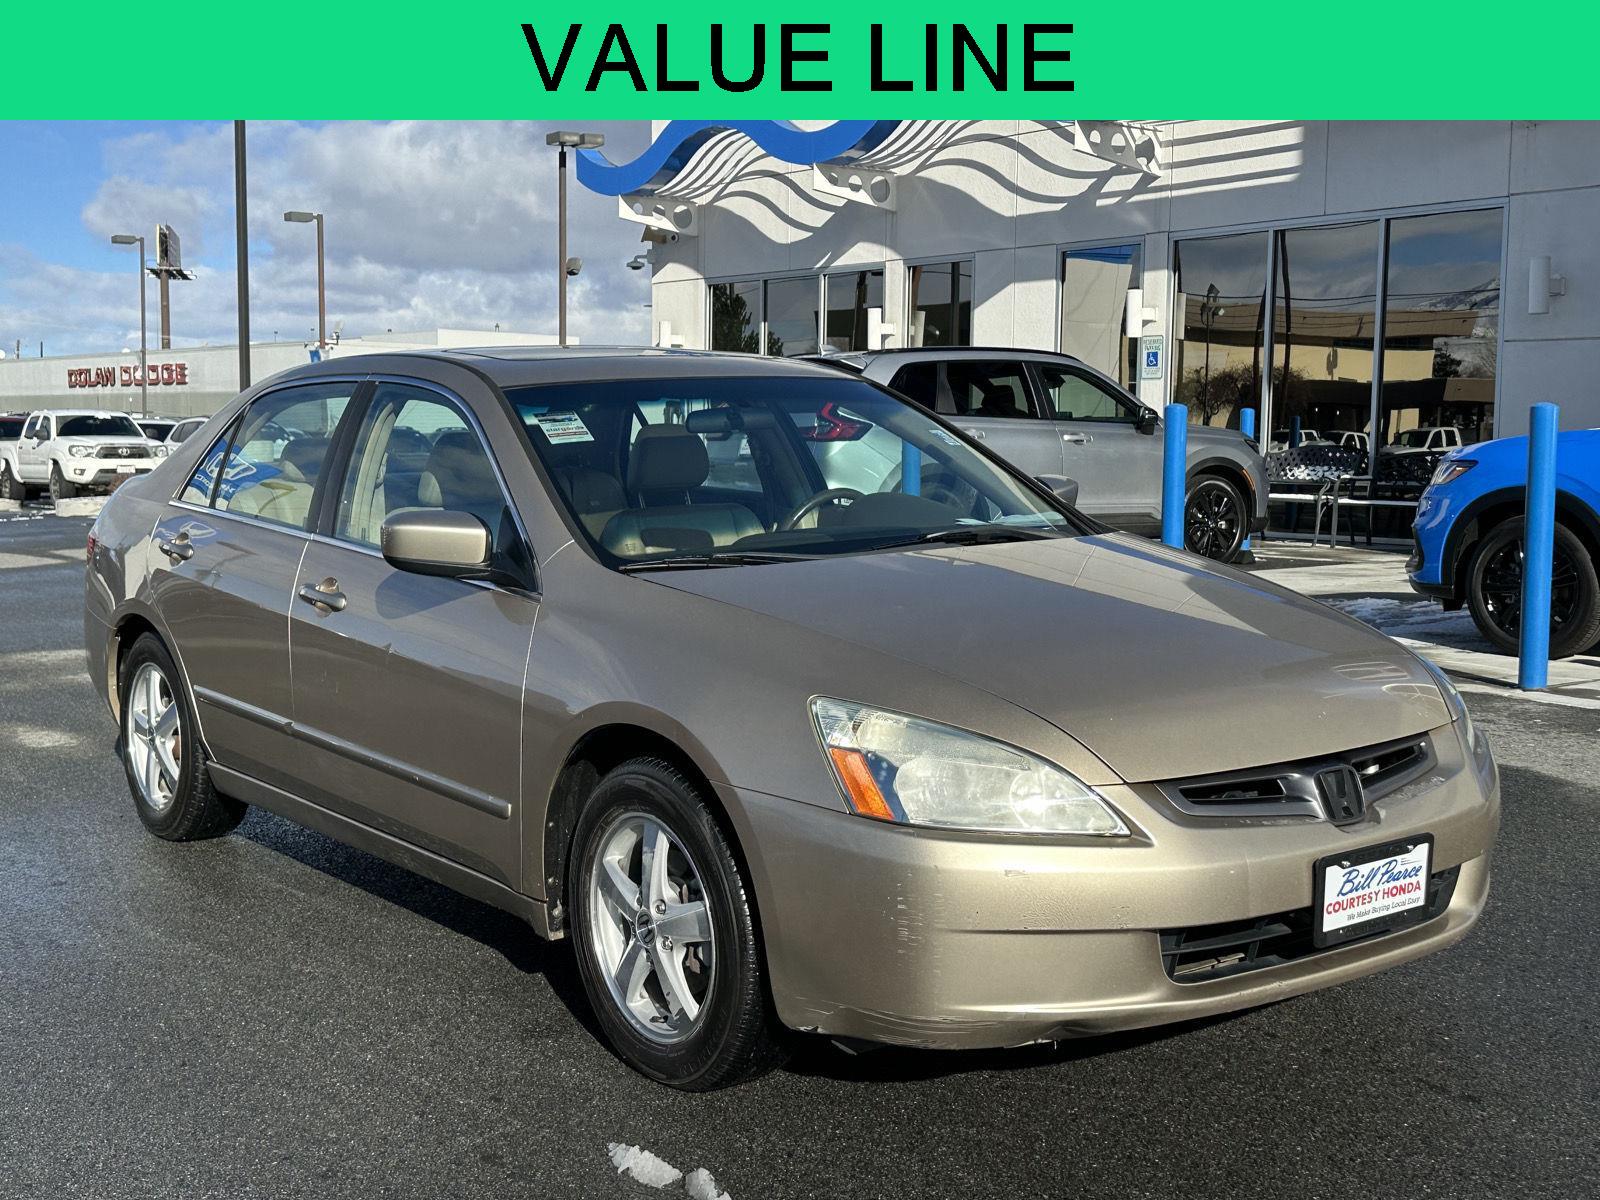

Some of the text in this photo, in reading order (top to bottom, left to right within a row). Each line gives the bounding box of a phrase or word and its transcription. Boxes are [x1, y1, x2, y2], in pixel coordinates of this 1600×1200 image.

[68, 363, 188, 388] DOLAN DODGE
[1336, 859, 1422, 897] Bill Pearce
[1326, 880, 1422, 915] COURTESY HONDA
[1347, 913, 1356, 921] We
[1356, 908, 1371, 919] Make
[1371, 903, 1391, 914] Buying
[1391, 898, 1407, 909] Local
